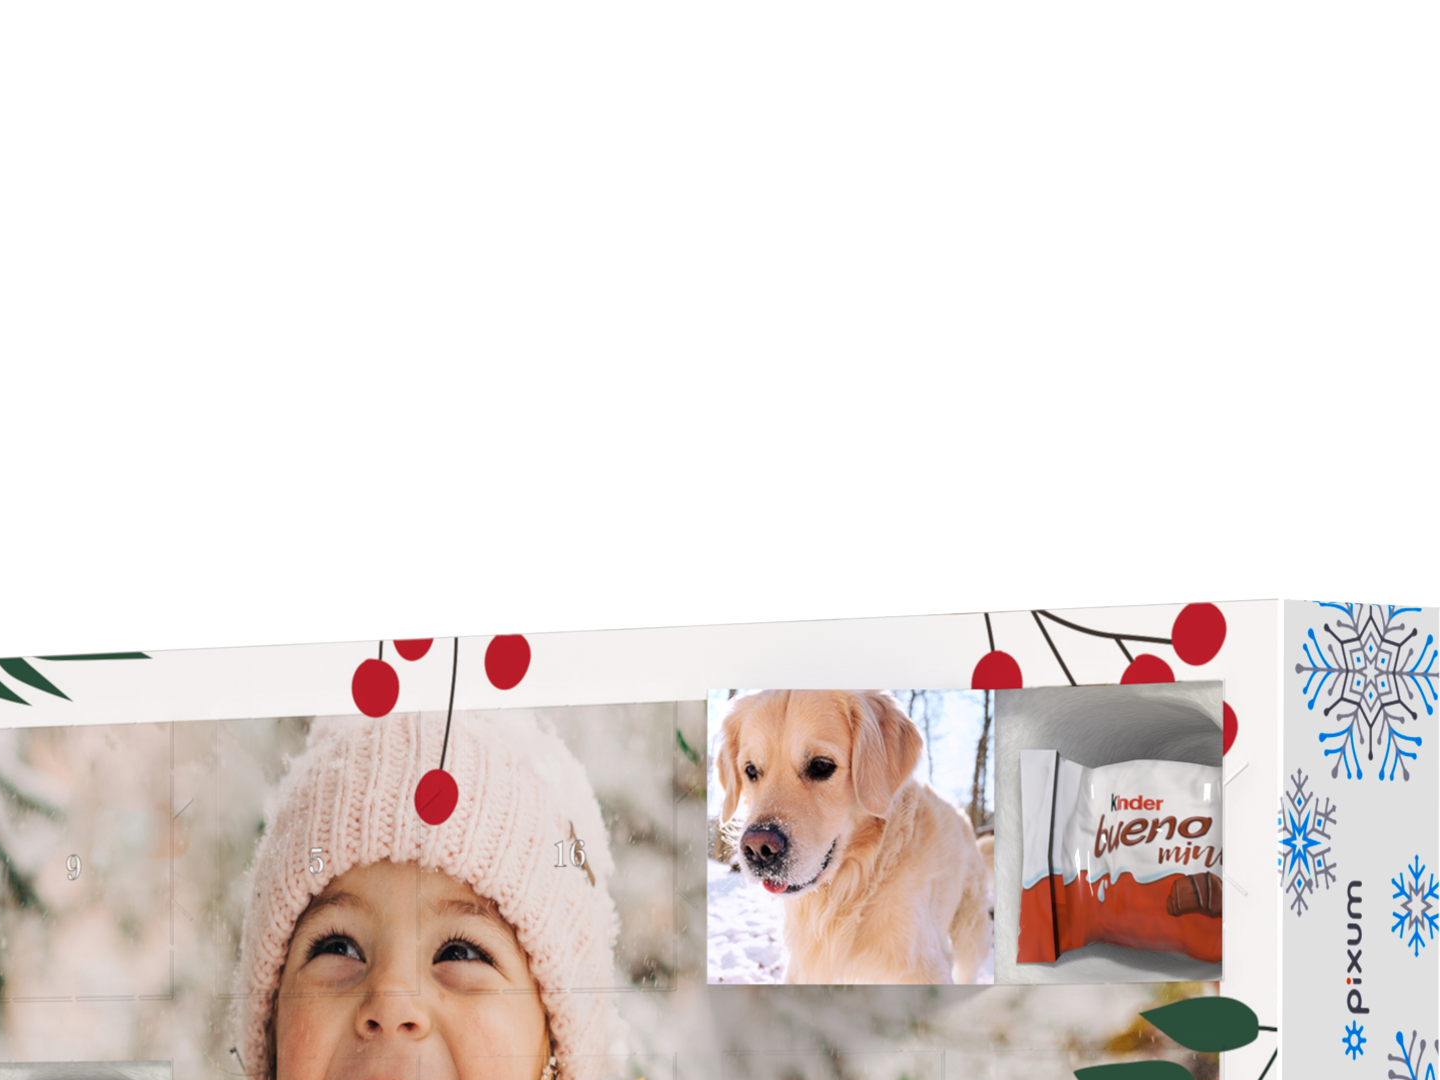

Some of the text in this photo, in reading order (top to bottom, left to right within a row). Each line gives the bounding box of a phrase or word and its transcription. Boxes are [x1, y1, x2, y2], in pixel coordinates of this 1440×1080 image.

[1094, 813, 1213, 858] bueno
[66, 854, 82, 881] 9
[308, 847, 325, 875] 5
[554, 839, 586, 868] 16
[1346, 880, 1370, 1014] pixum
